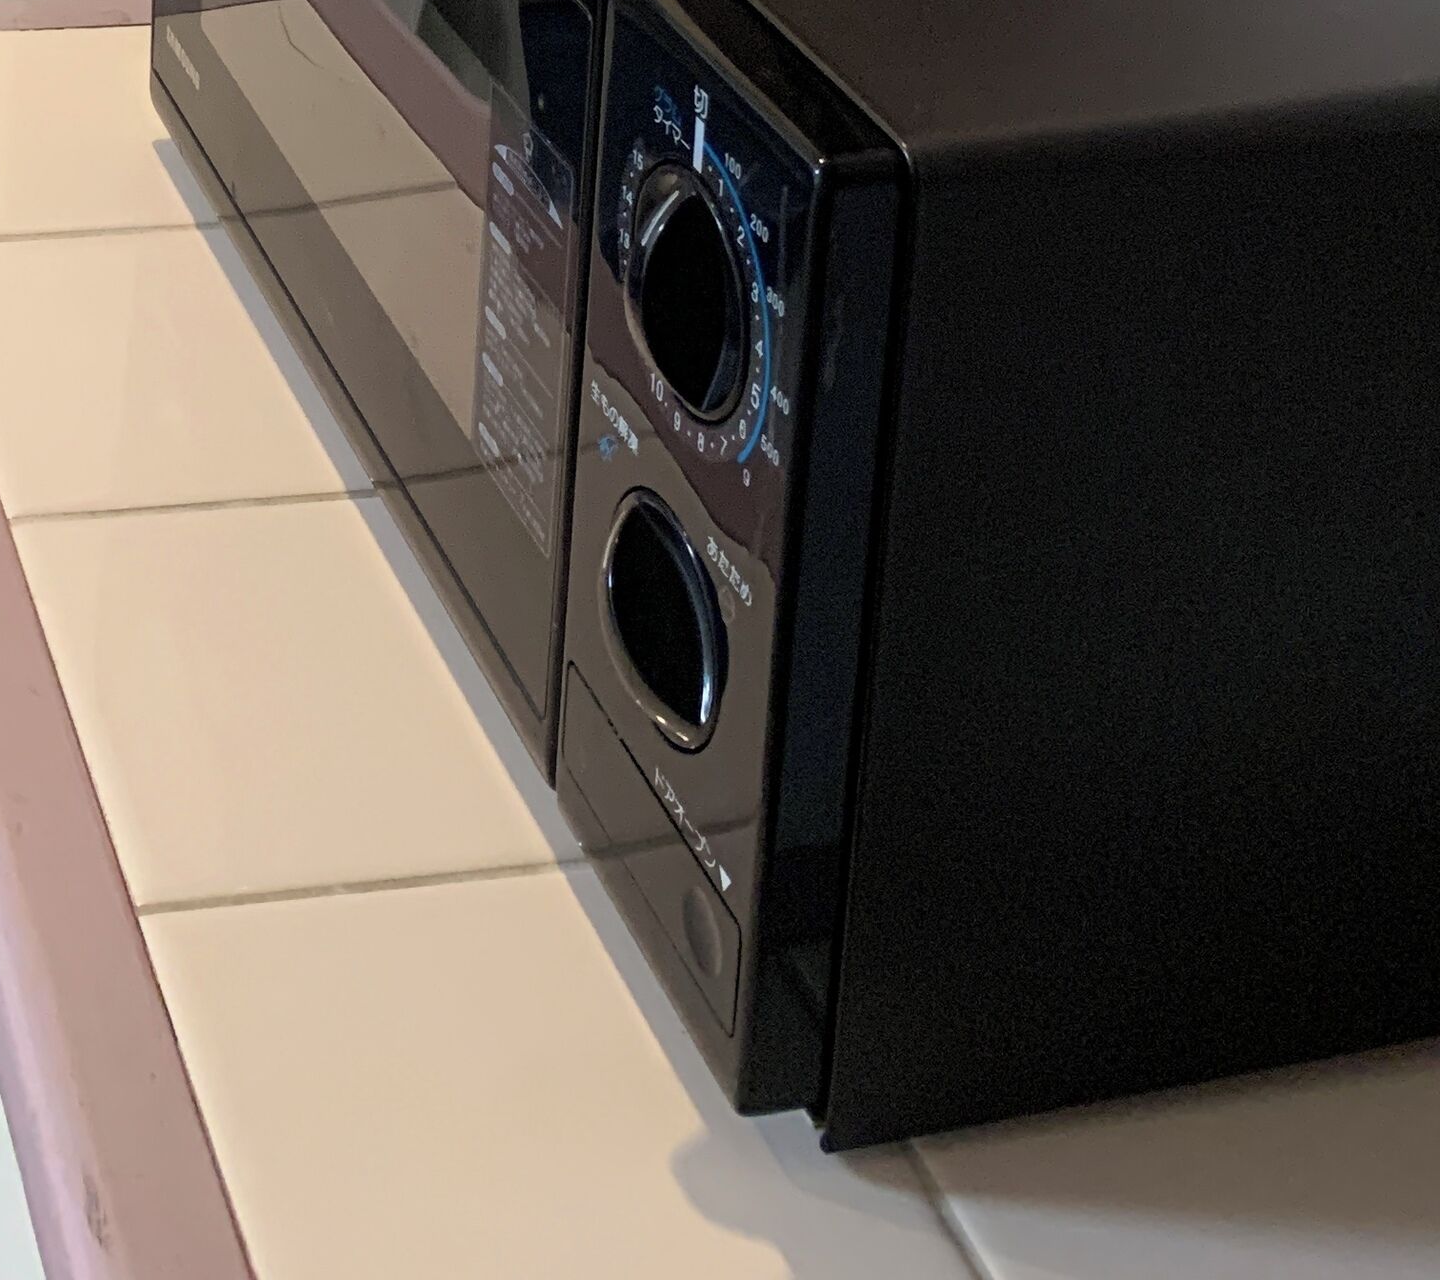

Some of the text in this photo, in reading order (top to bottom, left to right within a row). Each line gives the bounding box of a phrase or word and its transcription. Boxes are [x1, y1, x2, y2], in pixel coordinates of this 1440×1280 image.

[653, 104, 691, 151] タイマー
[632, 149, 644, 170] 15
[724, 152, 742, 180] 100
[622, 185, 633, 206] 14
[718, 178, 724, 197] 1
[736, 225, 745, 247] 2
[750, 213, 769, 243] 200
[750, 281, 759, 303] 3
[766, 286, 785, 317] 300
[754, 339, 764, 359] 4
[649, 373, 664, 402] 10
[750, 382, 761, 409] 5
[770, 385, 789, 416] 400
[674, 411, 681, 431] 9
[697, 432, 705, 452] 8
[721, 436, 728, 456] 7
[760, 433, 779, 467] 500
[706, 535, 753, 608] あたため
[654, 766, 716, 869] ドアオープン
